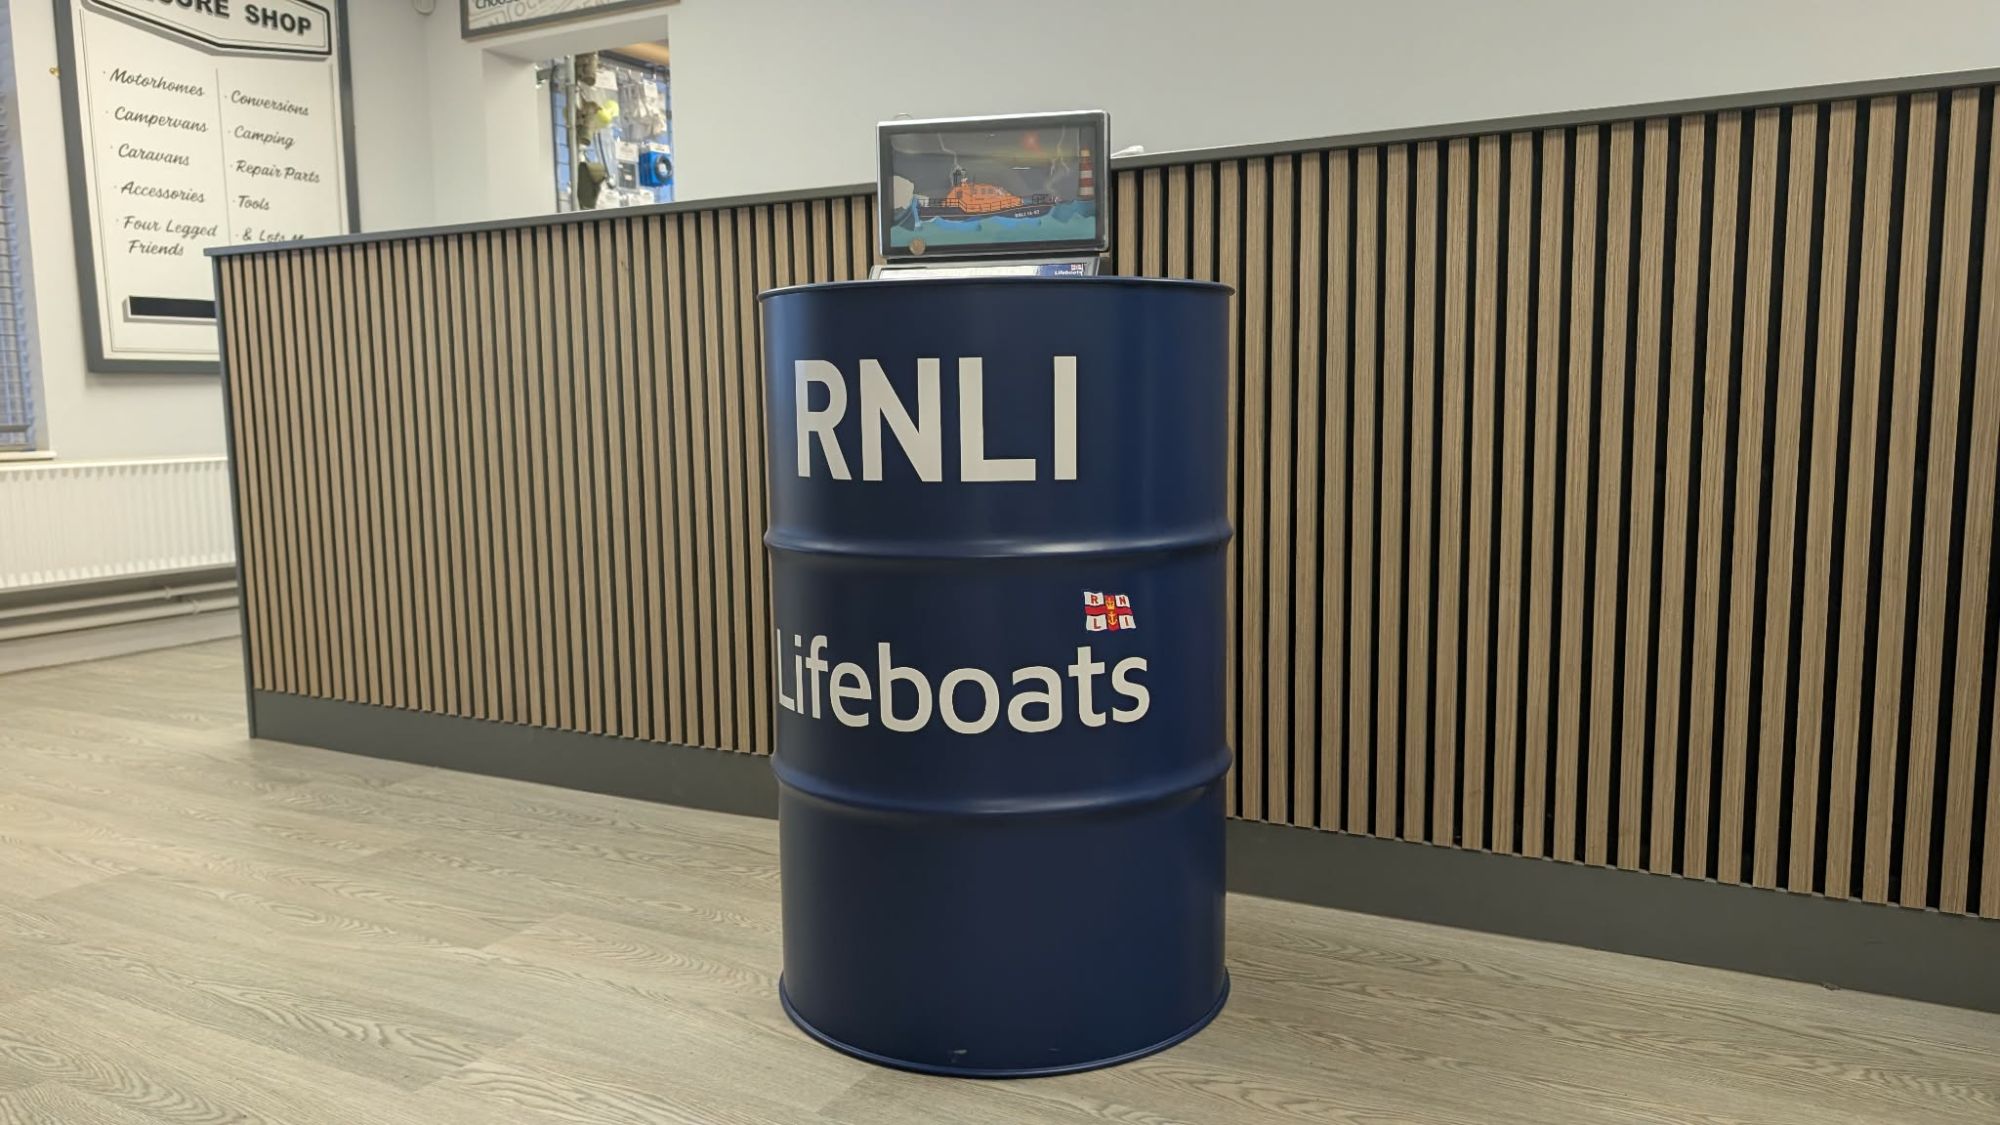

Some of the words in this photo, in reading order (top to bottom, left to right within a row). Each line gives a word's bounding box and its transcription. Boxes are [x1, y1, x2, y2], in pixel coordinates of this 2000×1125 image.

[244, 4, 312, 36] SHOP
[109, 68, 205, 96] Motorhomes
[231, 90, 309, 116] Conversions
[114, 106, 208, 133] Campervans
[234, 125, 295, 150] Camping
[118, 143, 190, 166] Caravans
[236, 159, 282, 178] Repair
[283, 166, 320, 183] Parts
[120, 181, 205, 203] Accessories
[238, 194, 270, 211] Tools
[124, 215, 161, 231] Four
[166, 219, 218, 239] Legged
[128, 239, 184, 256] Friends
[794, 355, 1077, 482] RNLI
[776, 628, 1150, 735] Lifeboats
